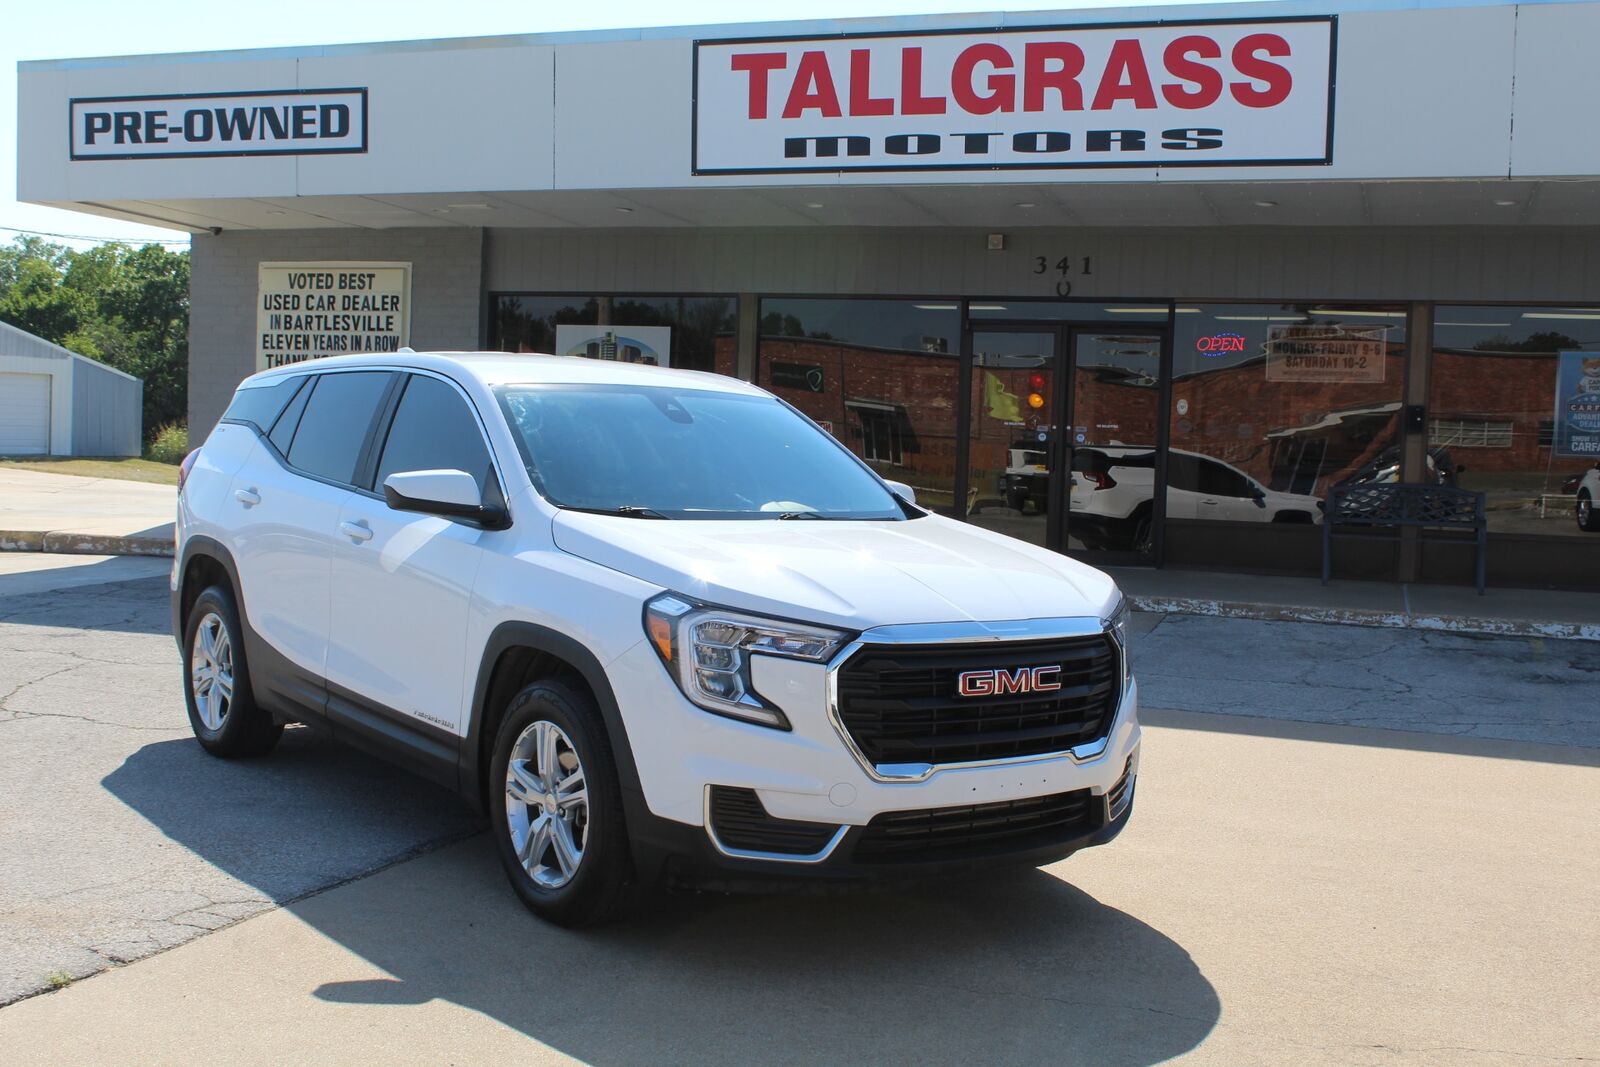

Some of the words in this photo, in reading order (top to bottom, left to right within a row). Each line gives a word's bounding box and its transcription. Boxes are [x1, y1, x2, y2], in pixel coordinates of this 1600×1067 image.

[731, 33, 1293, 120] TALLGRASS
[84, 104, 350, 145] PRE-OWNED
[784, 128, 1223, 159] MOTORS
[288, 273, 334, 290] VOTED
[339, 273, 376, 290] BEST
[264, 294, 300, 311] USED
[306, 294, 336, 311] CAR
[342, 295, 400, 312] DEALER
[270, 314, 281, 330] IN
[284, 314, 394, 332] BARTLESVILLE
[262, 333, 310, 350] ELEVEN
[313, 334, 347, 351] YEARS
[351, 335, 362, 351] IN
[365, 335, 372, 351] A
[375, 335, 400, 352] ROW
[1196, 336, 1245, 351] OPEN
[1272, 342, 1359, 355] MONDAY-FRIDAY
[1285, 355, 1339, 368] SATURDAY
[1343, 356, 1367, 369] 10-2
[958, 665, 1062, 696] GMC
